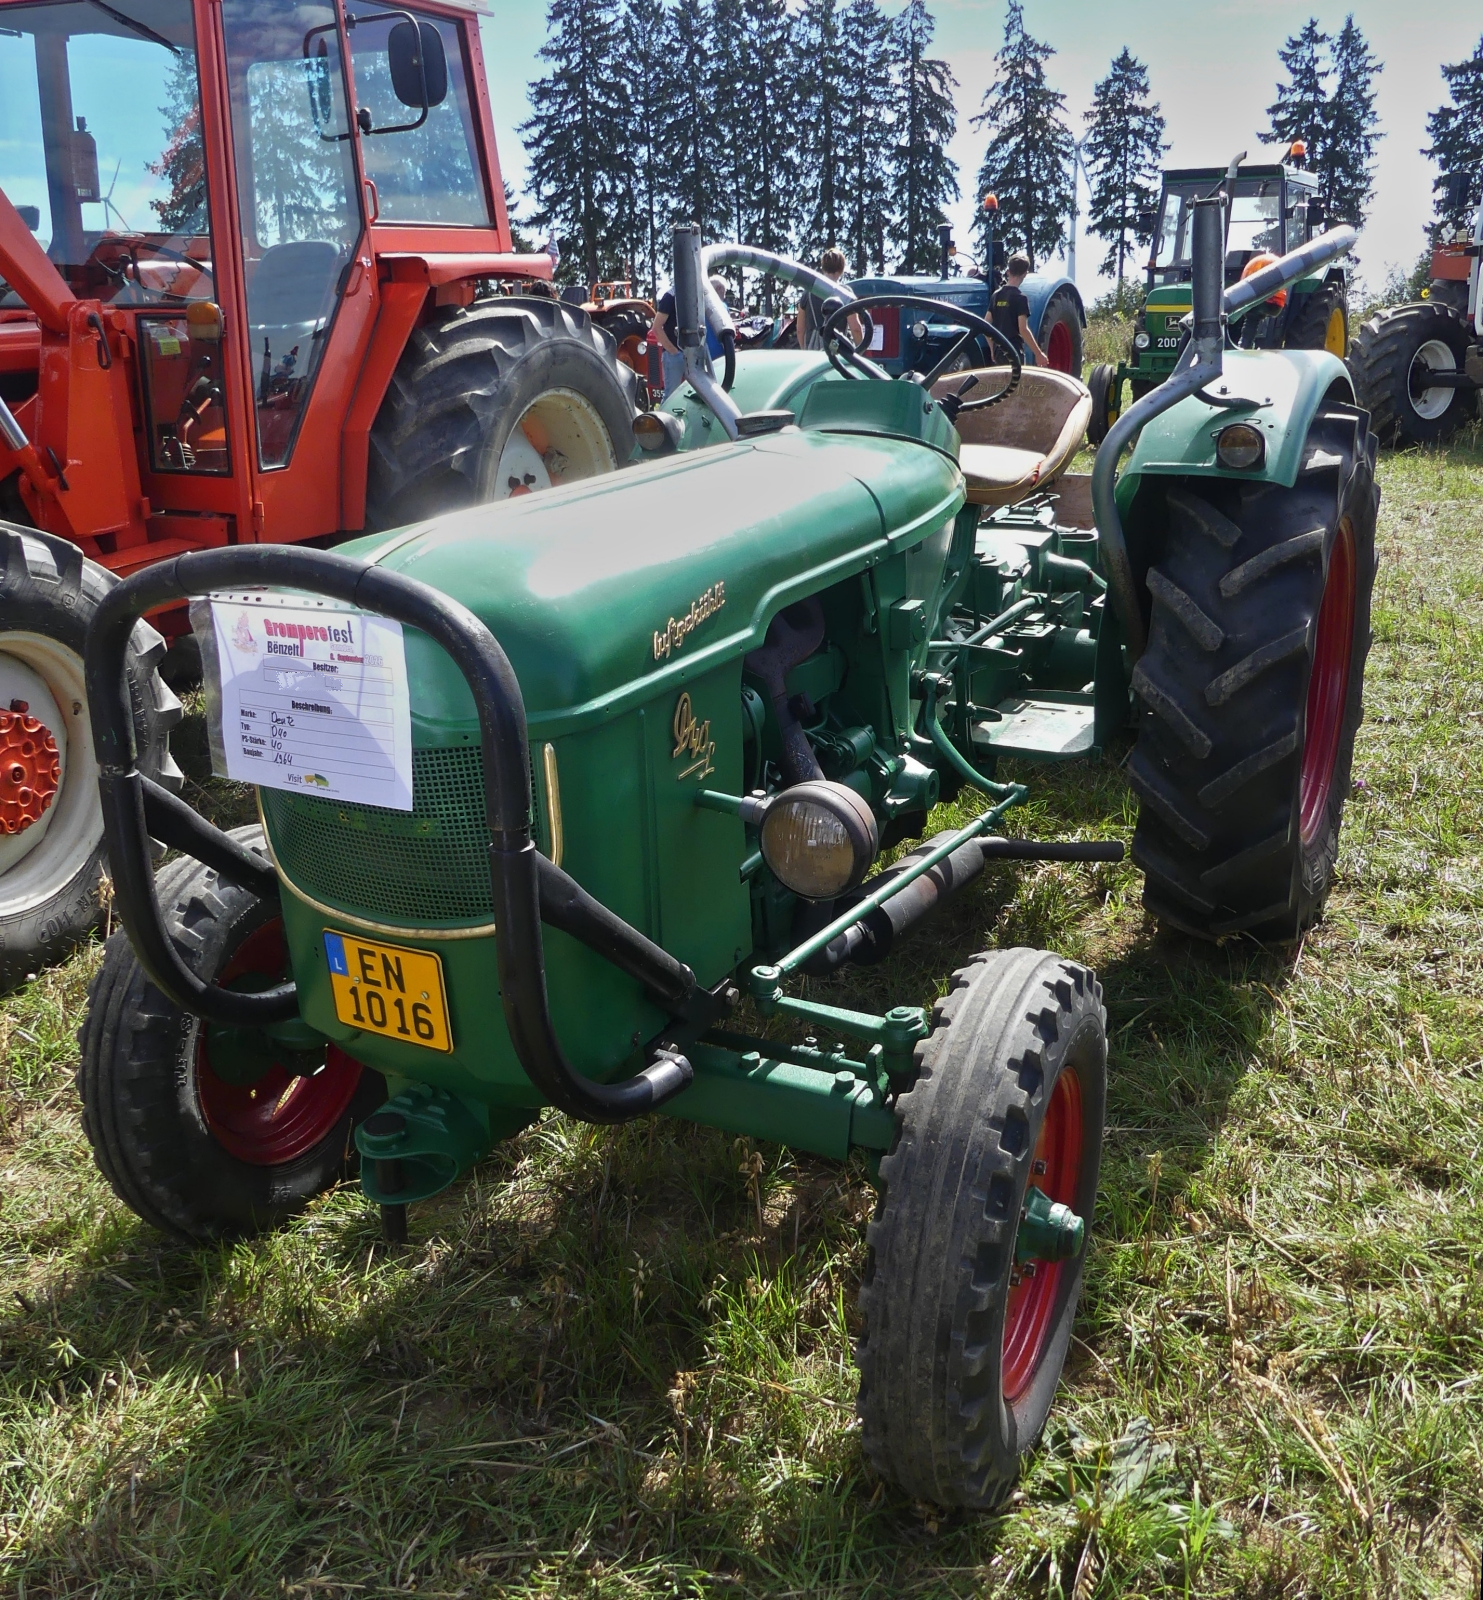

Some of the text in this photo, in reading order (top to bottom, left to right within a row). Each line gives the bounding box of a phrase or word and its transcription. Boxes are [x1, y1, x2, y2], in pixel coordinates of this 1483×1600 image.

[1157, 337, 1181, 348] 200
[263, 618, 354, 658] Gromperefest
[267, 641, 300, 656] Bënzelt
[313, 661, 339, 674] Besitzer:
[240, 709, 257, 719] Marke:
[291, 700, 333, 715] Beschreibung:
[240, 721, 252, 731] Typ:
[271, 739, 283, 751] 40
[242, 747, 264, 758] Baujahr:
[273, 752, 293, 765] 1964
[287, 773, 302, 784] Visit
[334, 957, 342, 970] L
[357, 947, 406, 993] EN
[349, 986, 434, 1040] 1016
